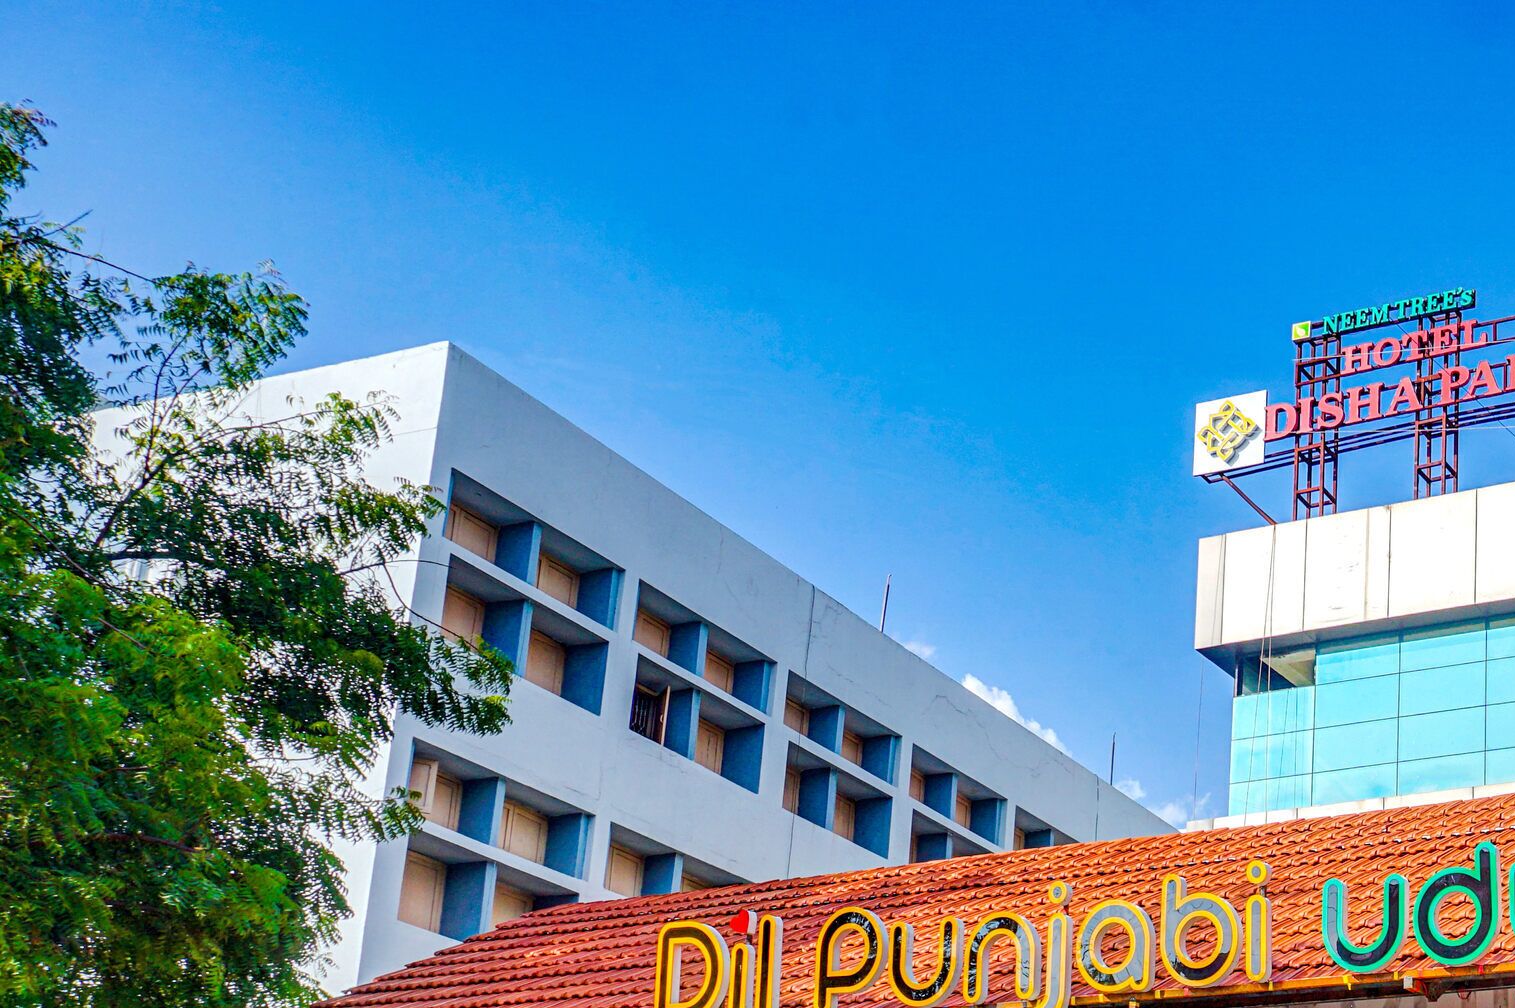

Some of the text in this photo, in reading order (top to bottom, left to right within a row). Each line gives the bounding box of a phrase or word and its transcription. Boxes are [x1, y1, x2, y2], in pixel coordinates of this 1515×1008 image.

[1322, 304, 1390, 335] NEEM
[1340, 319, 1488, 376] HOTEL
[1264, 376, 1422, 442] DISHA
